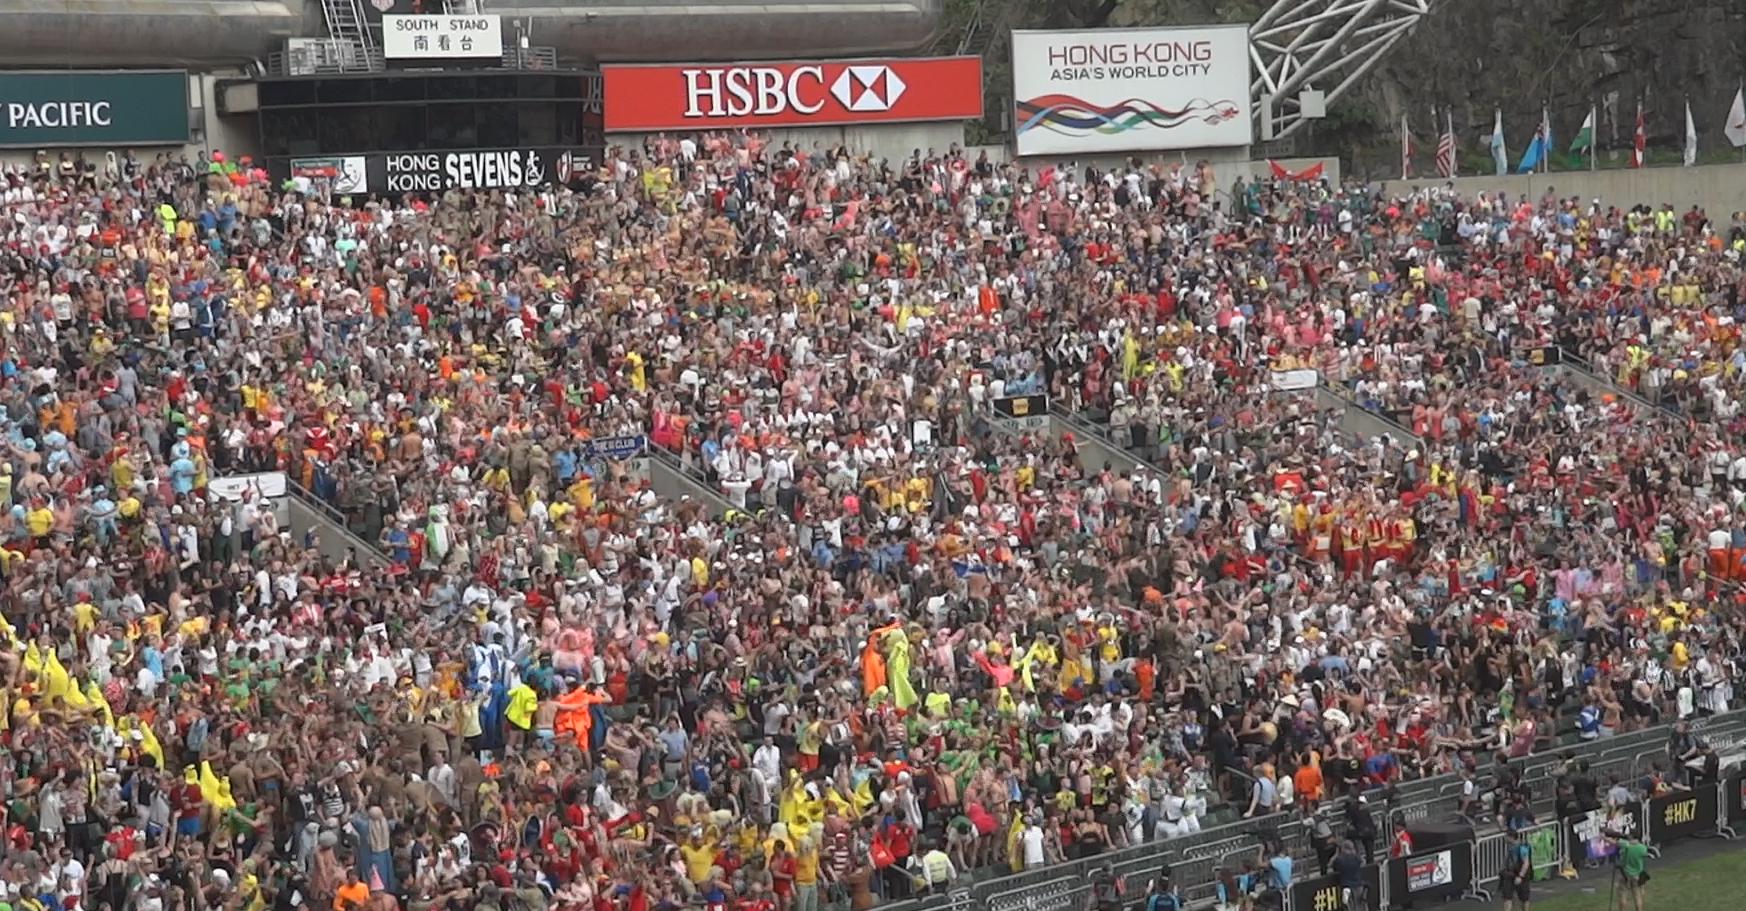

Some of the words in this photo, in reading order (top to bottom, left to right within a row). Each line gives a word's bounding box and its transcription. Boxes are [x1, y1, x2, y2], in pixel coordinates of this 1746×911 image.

[396, 19, 439, 31] SOUTH
[449, 19, 489, 31] STAND
[413, 34, 473, 51] 南看台
[1048, 44, 1128, 66] HONG
[1134, 41, 1212, 63] KONG
[1050, 67, 1105, 81] ASIA'S
[1108, 65, 1170, 79] WORLD
[1172, 63, 1211, 78] CITY
[682, 66, 825, 116] HSBC
[8, 101, 112, 128] PACIFIC
[386, 154, 440, 172] HONG
[445, 151, 523, 188] SEVENS
[387, 174, 441, 191] KONG
[1664, 799, 1697, 826] #HK7
[1314, 886, 1338, 911] #H
